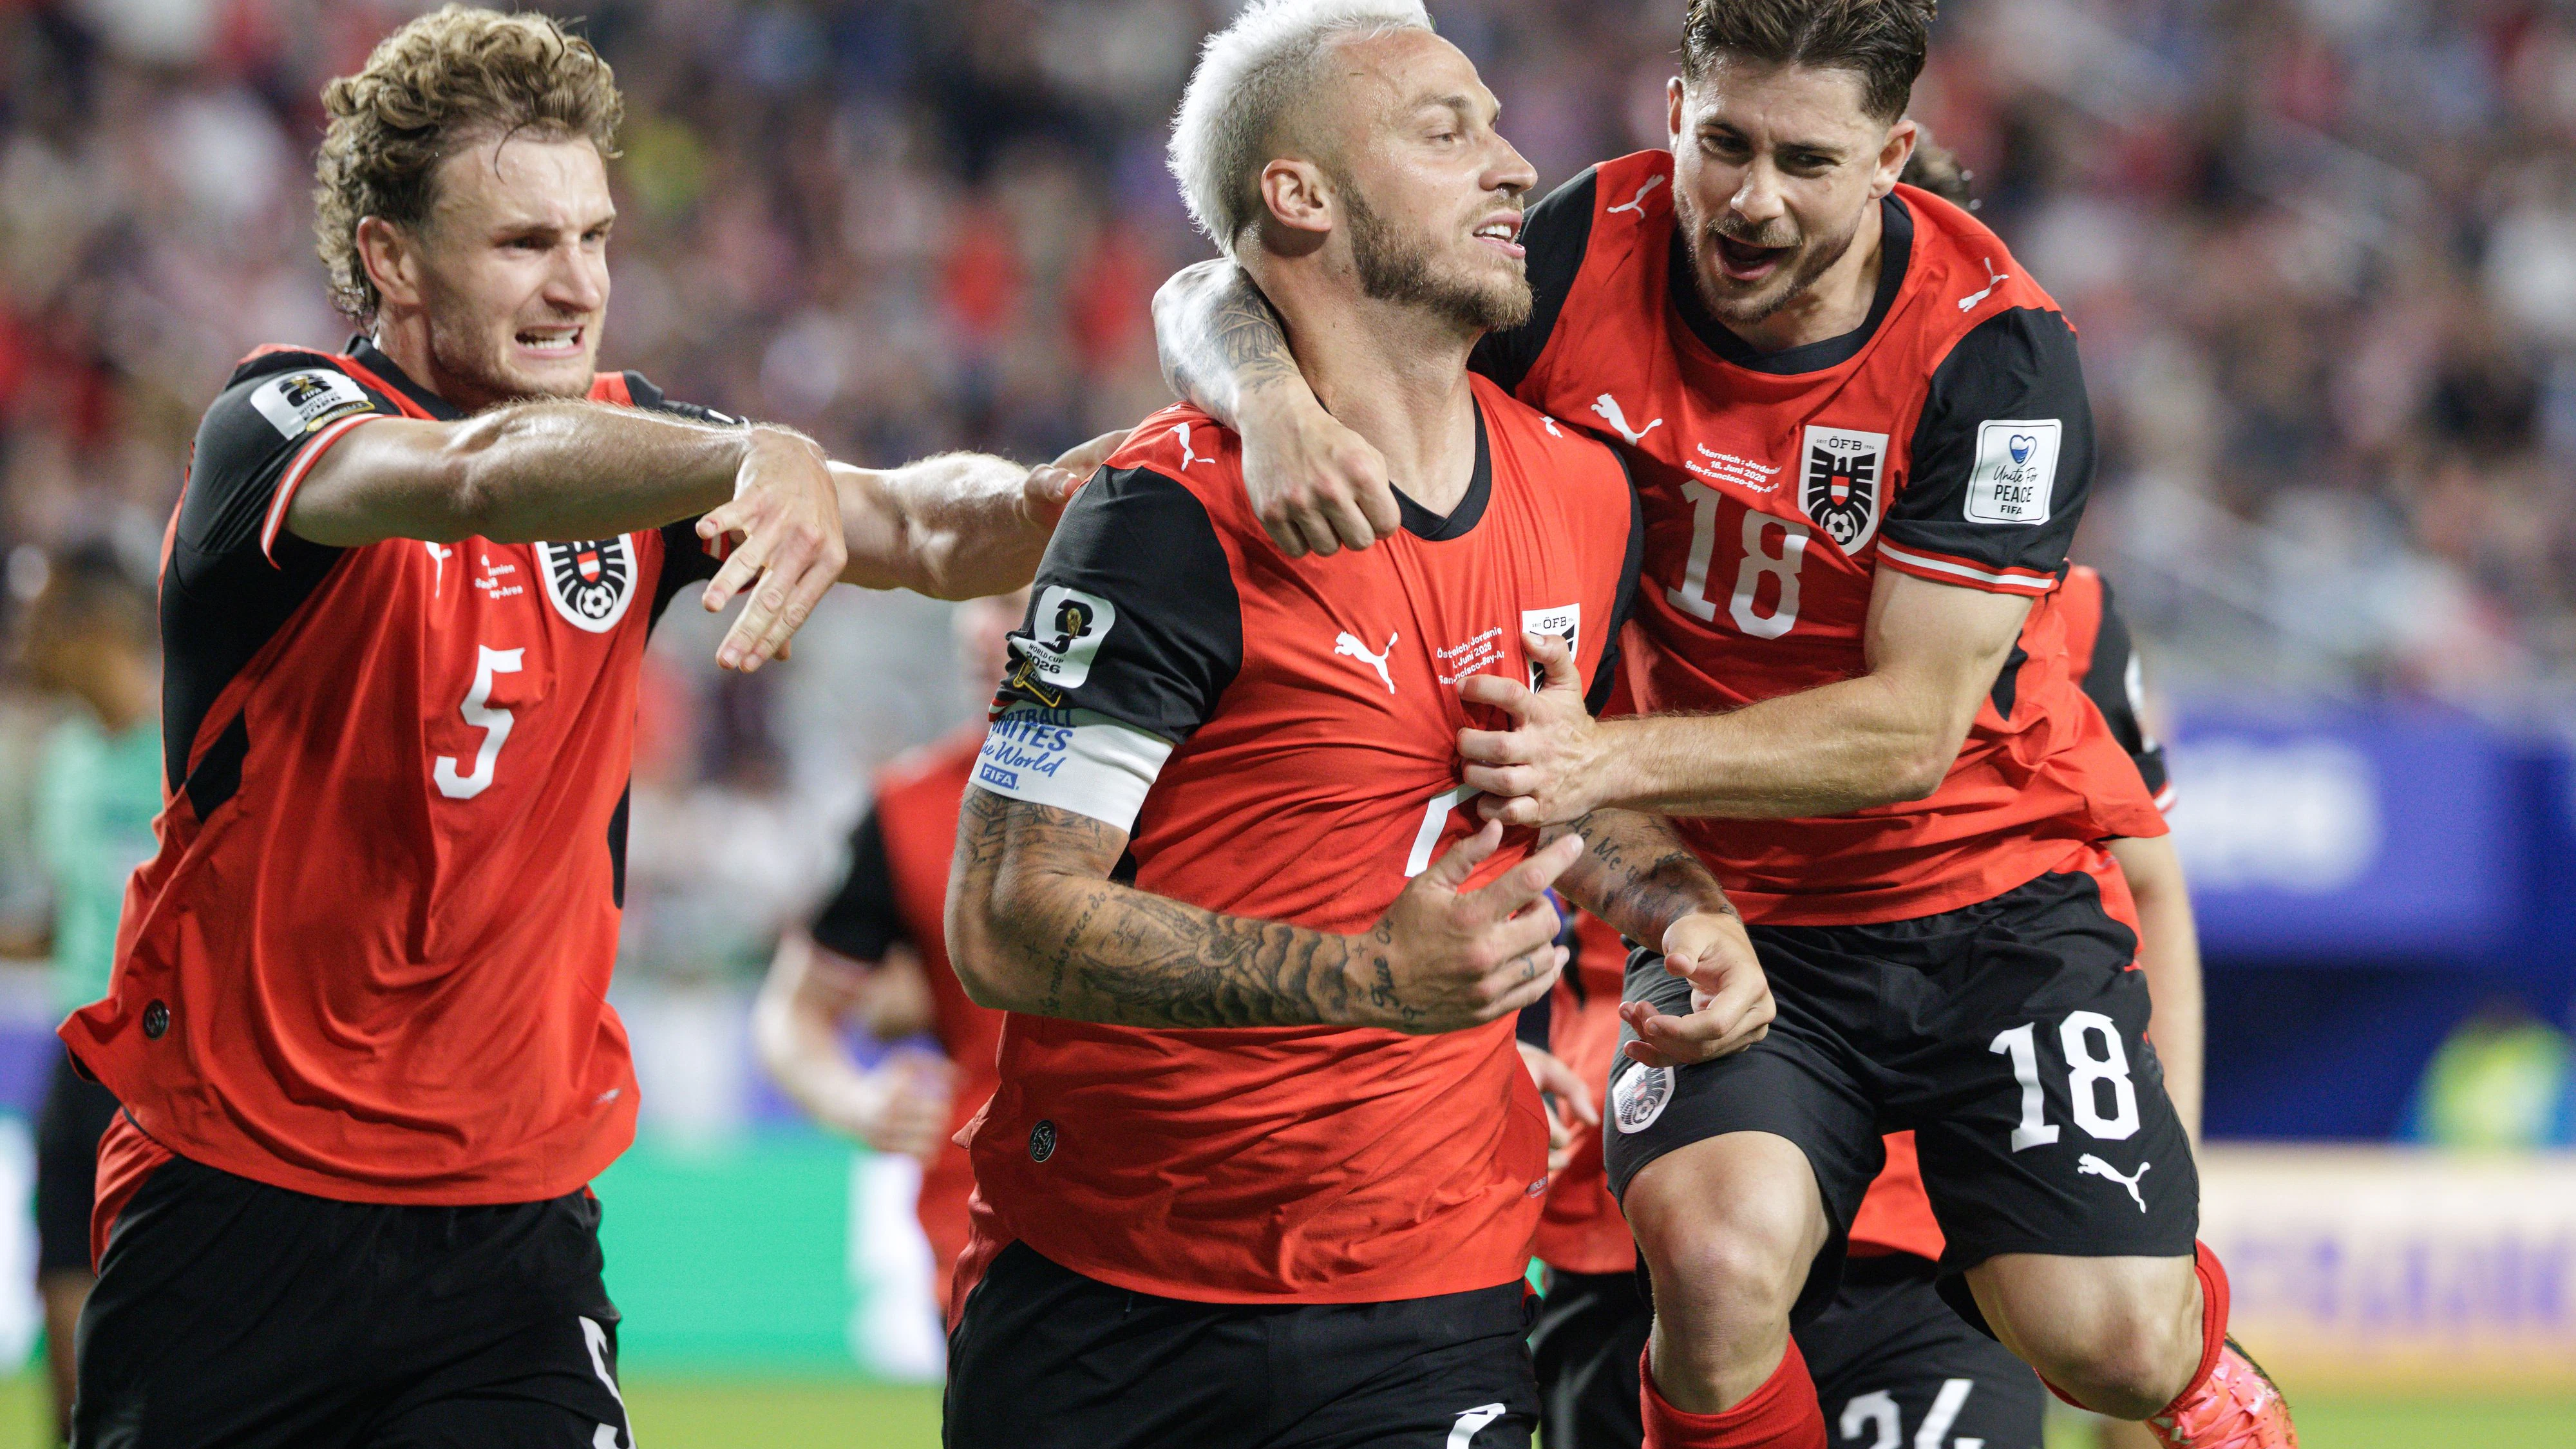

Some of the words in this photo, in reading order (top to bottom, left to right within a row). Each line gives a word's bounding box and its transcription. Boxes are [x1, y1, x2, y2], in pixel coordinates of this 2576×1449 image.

[1829, 435, 1862, 450] ÖFB
[1710, 460, 1723, 469] 16.
[1723, 464, 1743, 475] Juni
[1744, 469, 1766, 482] 2026
[1994, 465, 2024, 484] Unite
[2025, 467, 2039, 484] For
[1994, 484, 2034, 503] PEACE
[2000, 505, 2023, 515] FIFA
[1665, 478, 1812, 640] 18
[1543, 616, 1566, 629] ÖFB
[1028, 643, 1048, 658] WORLD
[1048, 656, 1064, 664] CUP
[1458, 650, 1474, 667] Juni
[1473, 641, 1492, 657] 2026
[433, 644, 526, 799] 5
[992, 720, 1074, 752] UNITES
[994, 741, 1067, 778] World
[982, 766, 1014, 786] FIFA
[1989, 1010, 2141, 1153] 18
